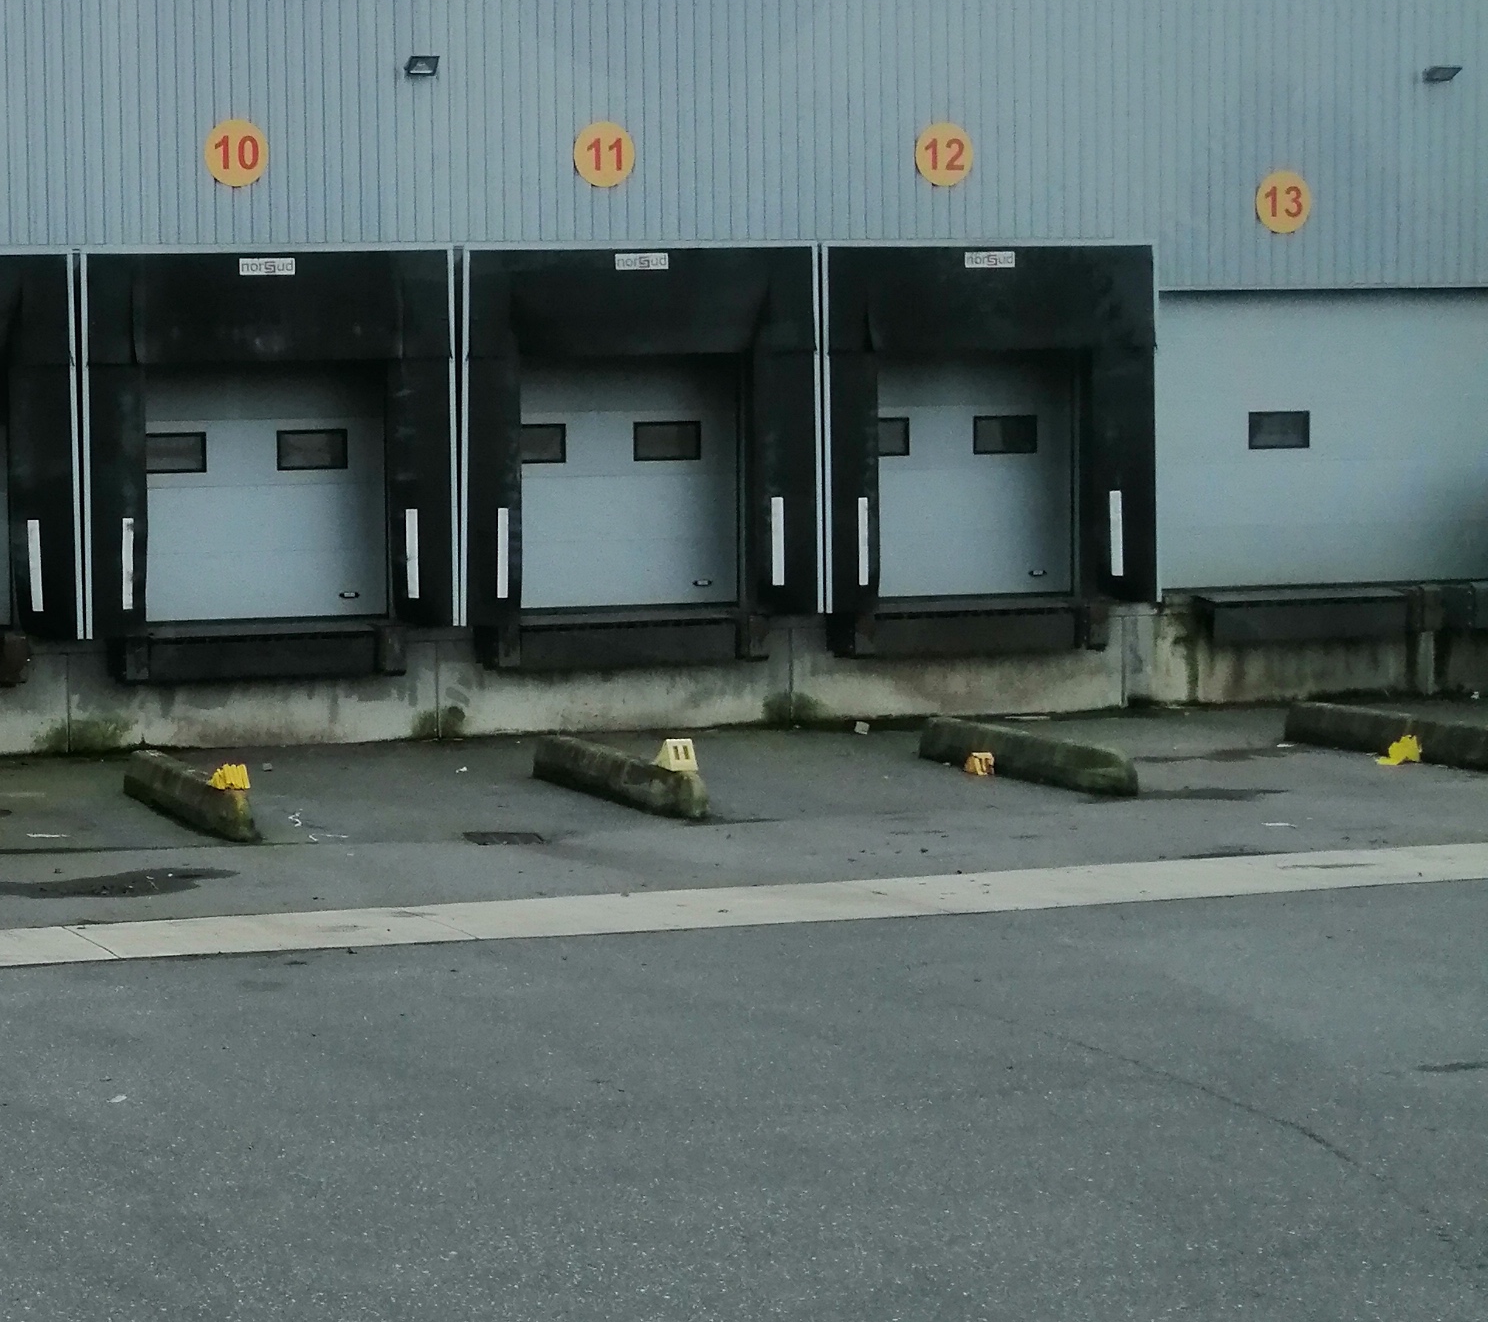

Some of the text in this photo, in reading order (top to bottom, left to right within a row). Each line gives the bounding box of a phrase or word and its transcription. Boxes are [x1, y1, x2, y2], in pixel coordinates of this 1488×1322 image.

[214, 135, 260, 171] 10
[586, 137, 623, 172] 11
[924, 137, 965, 171] 12
[1264, 185, 1304, 219] 13
